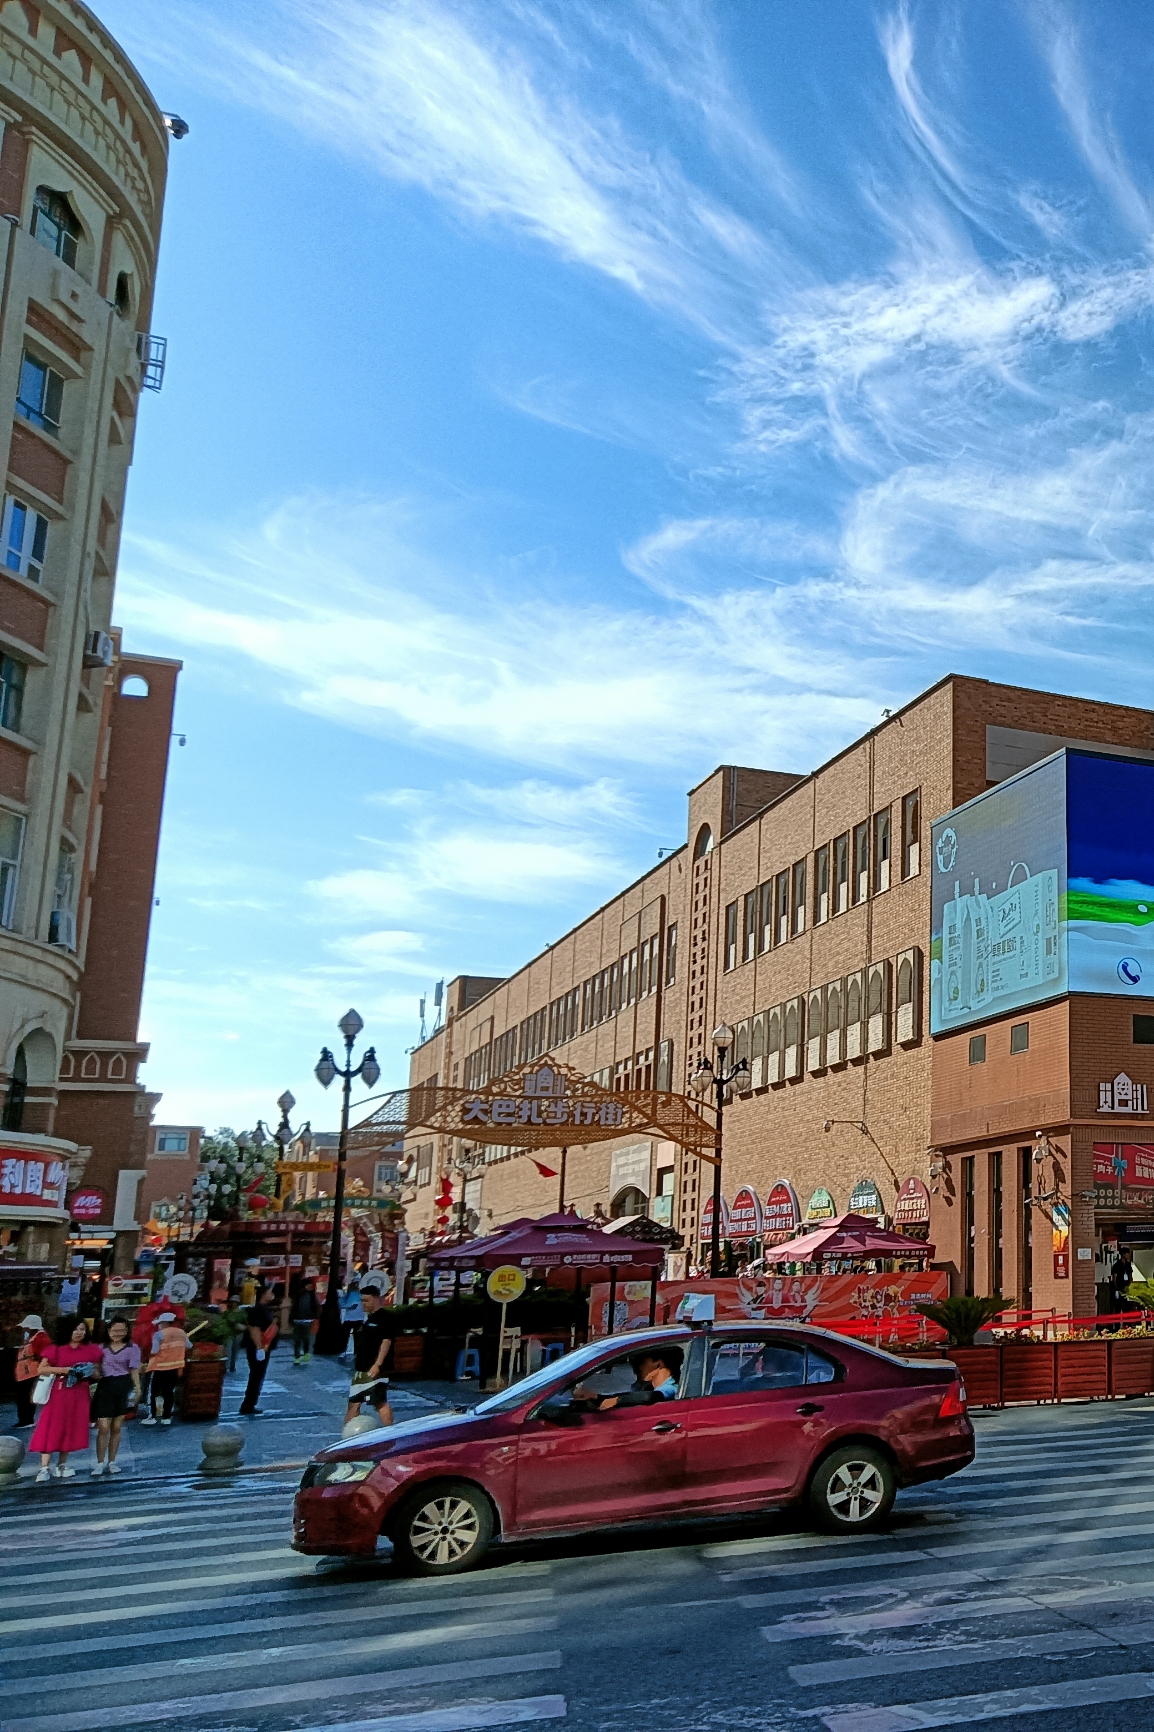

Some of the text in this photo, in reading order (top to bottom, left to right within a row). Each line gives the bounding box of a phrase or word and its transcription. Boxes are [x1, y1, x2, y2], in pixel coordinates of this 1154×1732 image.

[462, 1098, 623, 1126] 大巴扎步行街
[1, 1158, 45, 1195] 利朗
[497, 1272, 516, 1283] 出口
